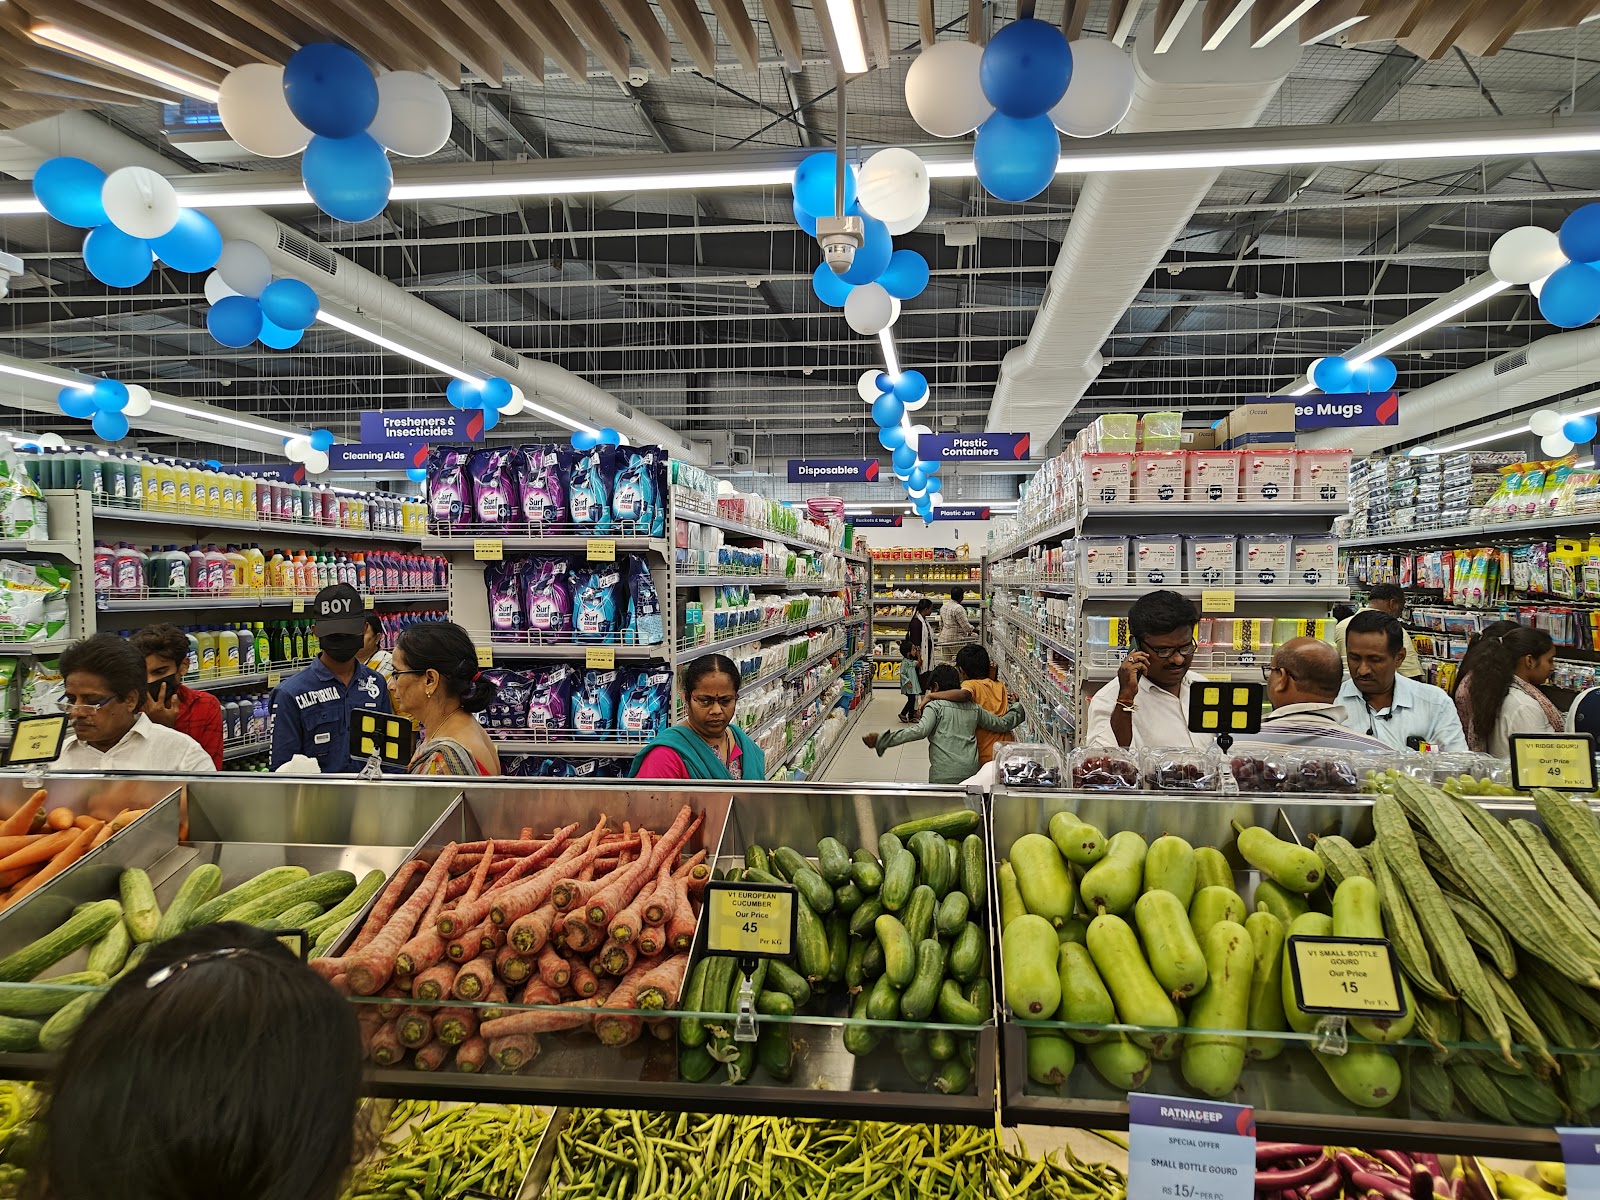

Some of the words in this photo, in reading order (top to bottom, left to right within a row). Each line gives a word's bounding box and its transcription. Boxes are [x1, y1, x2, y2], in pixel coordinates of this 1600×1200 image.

[1249, 408, 1268, 416] Ocean
[1316, 403, 1362, 419] Mugs
[383, 416, 445, 427] Fresheners
[447, 416, 456, 426] &
[386, 426, 454, 437] Insecticides
[953, 438, 988, 448] Plastic
[342, 451, 383, 462] Cleaning
[384, 451, 405, 460] Aids
[942, 447, 999, 457] Containers
[798, 465, 859, 477] Disposables
[484, 496, 498, 506] Surf
[529, 497, 544, 506] Surf
[878, 517, 892, 525] Mugs
[321, 598, 351, 615] BOY
[499, 604, 513, 613] Surf
[536, 604, 551, 613] Surf
[584, 613, 598, 622] Surf
[295, 686, 341, 710] CALIFORNIA
[531, 711, 545, 720] Surf
[581, 712, 595, 721] Surf
[628, 710, 643, 718] Surf
[1547, 767, 1561, 776] 49
[738, 891, 777, 899] EUROPEAN
[732, 899, 772, 908] CUCUMBER
[735, 910, 749, 918] Our
[750, 911, 769, 919] Price
[742, 922, 758, 933] 45
[1347, 950, 1379, 958] BOTTLE
[1330, 958, 1360, 966] GOURD
[1329, 969, 1345, 977] Our
[1346, 970, 1368, 978] Price
[1341, 981, 1359, 993] 15
[1159, 1106, 1224, 1123] RATNADEEP
[1168, 1136, 1197, 1148] SPECIAL
[1197, 1140, 1220, 1150] OFFER
[1150, 1158, 1176, 1170] SMALL
[1178, 1162, 1207, 1173] BOTTLE
[1208, 1165, 1238, 1177] GOURD
[1162, 1185, 1173, 1195] RS
[1173, 1183, 1200, 1198] 15/-
[1199, 1191, 1214, 1200] PER
[1214, 1192, 1224, 1200] PC
